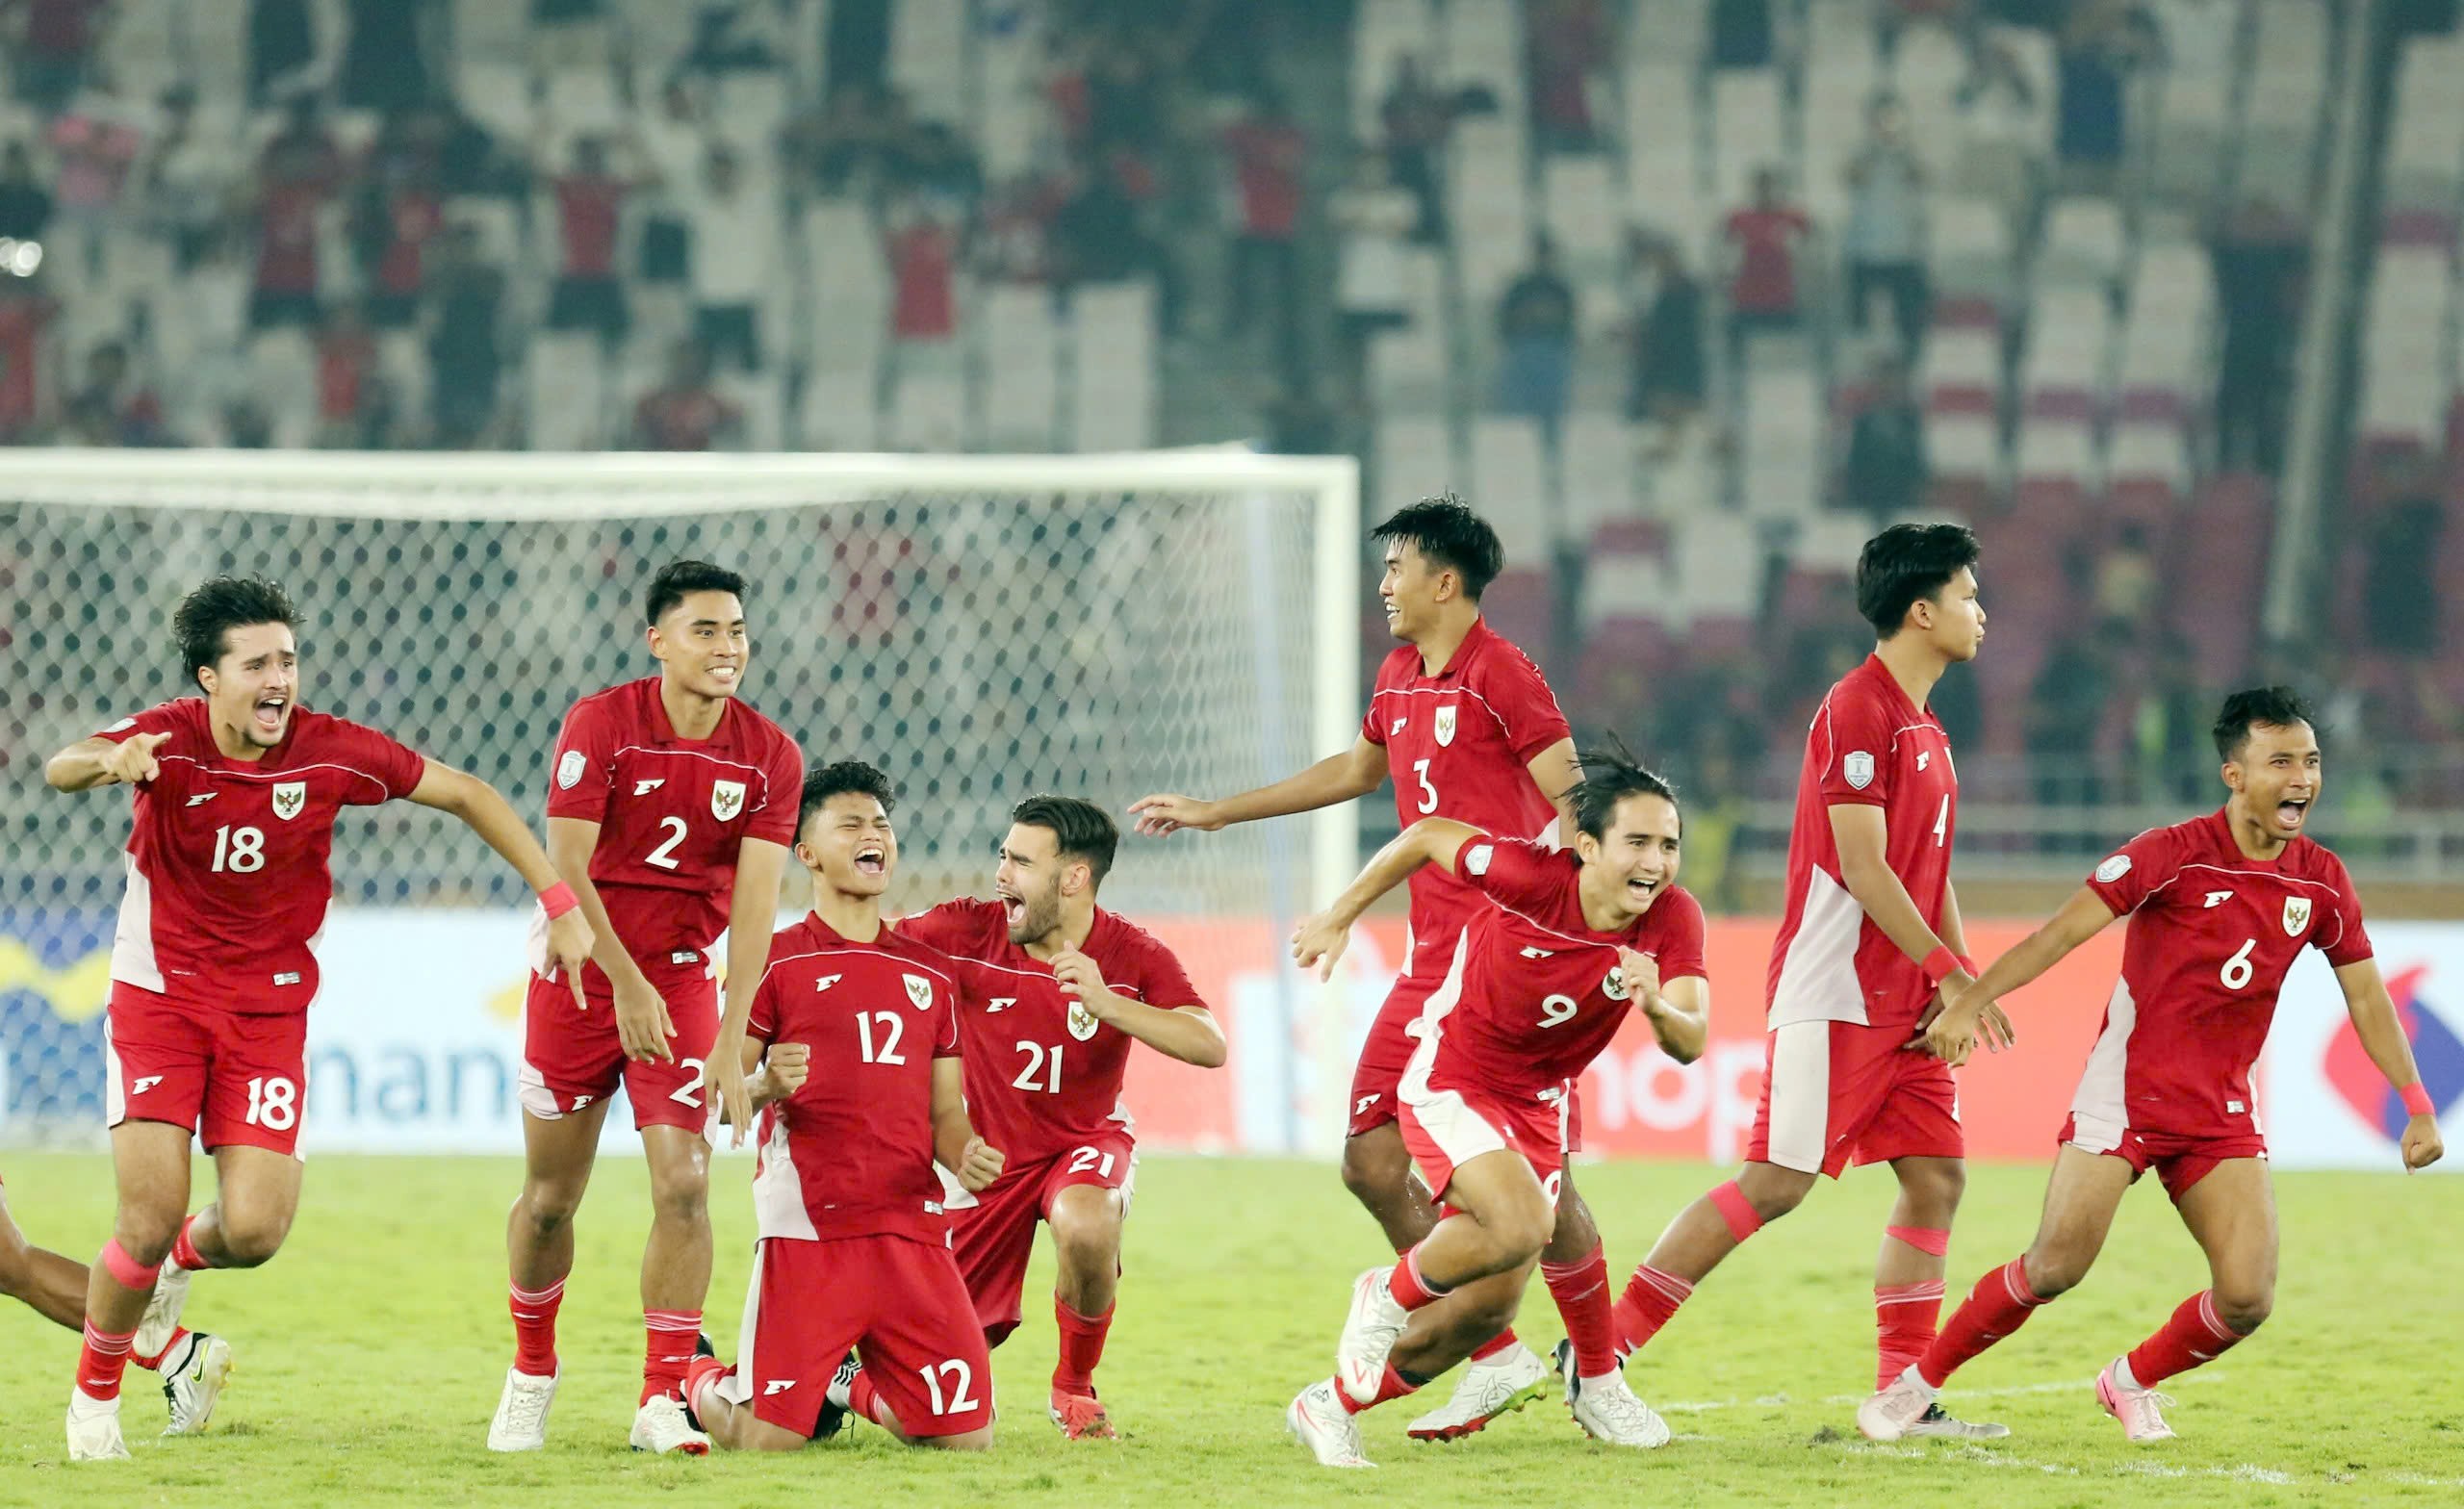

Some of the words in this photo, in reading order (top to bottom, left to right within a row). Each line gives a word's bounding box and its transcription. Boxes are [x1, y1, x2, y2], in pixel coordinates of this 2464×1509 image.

[1413, 758, 1438, 814] 3
[644, 816, 687, 870] 2
[1933, 793, 1950, 848] 4
[211, 825, 265, 873] 18
[2220, 938, 2257, 990] 6
[855, 1010, 906, 1066] 12
[1536, 994, 1578, 1029] 9
[668, 1058, 706, 1109] 2
[1012, 1040, 1064, 1094] 21
[245, 1077, 295, 1131] 18
[1067, 1145, 1116, 1179] 21
[919, 1359, 979, 1416] 12
